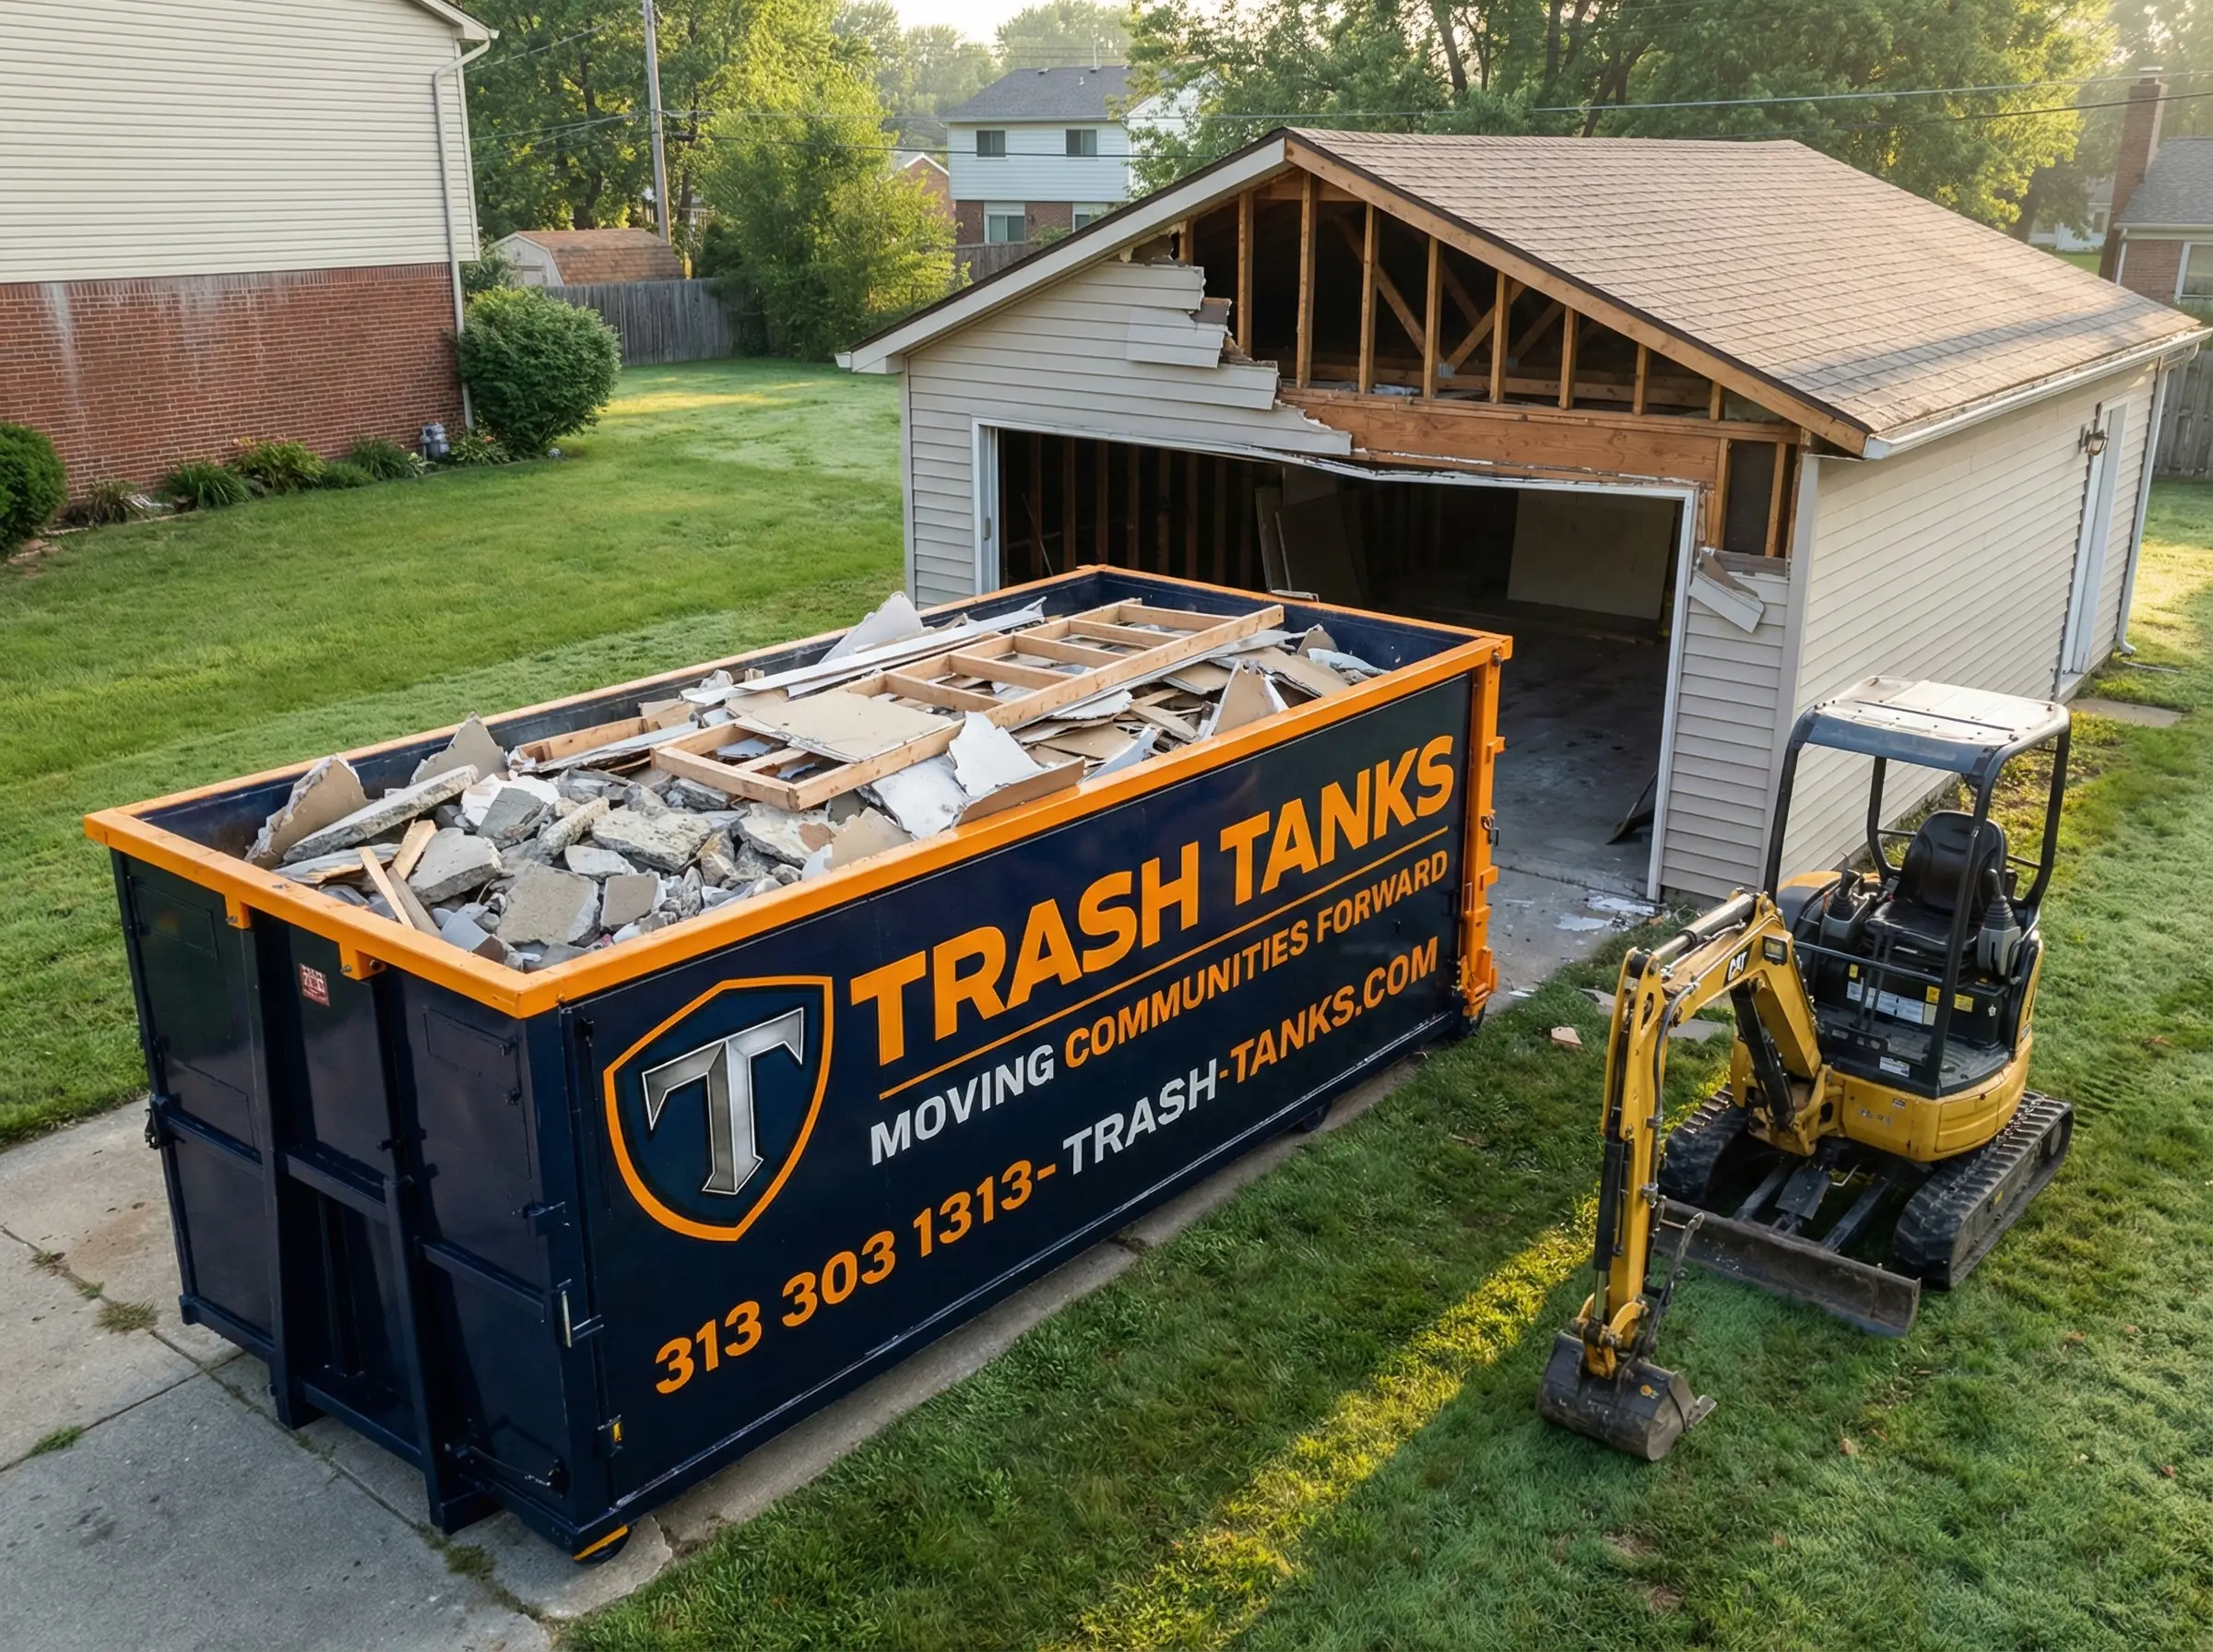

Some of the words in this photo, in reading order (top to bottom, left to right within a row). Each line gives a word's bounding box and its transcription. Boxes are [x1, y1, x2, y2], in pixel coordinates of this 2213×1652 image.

[849, 840, 1201, 1067] TRASH
[1219, 735, 1456, 906] TANKS
[870, 1043, 1055, 1166] MOVING
[1064, 919, 1309, 1069] COMMUNITIES
[1316, 850, 1449, 944] FORWARD
[655, 1300, 763, 1395] 313
[781, 1230, 897, 1328] 303
